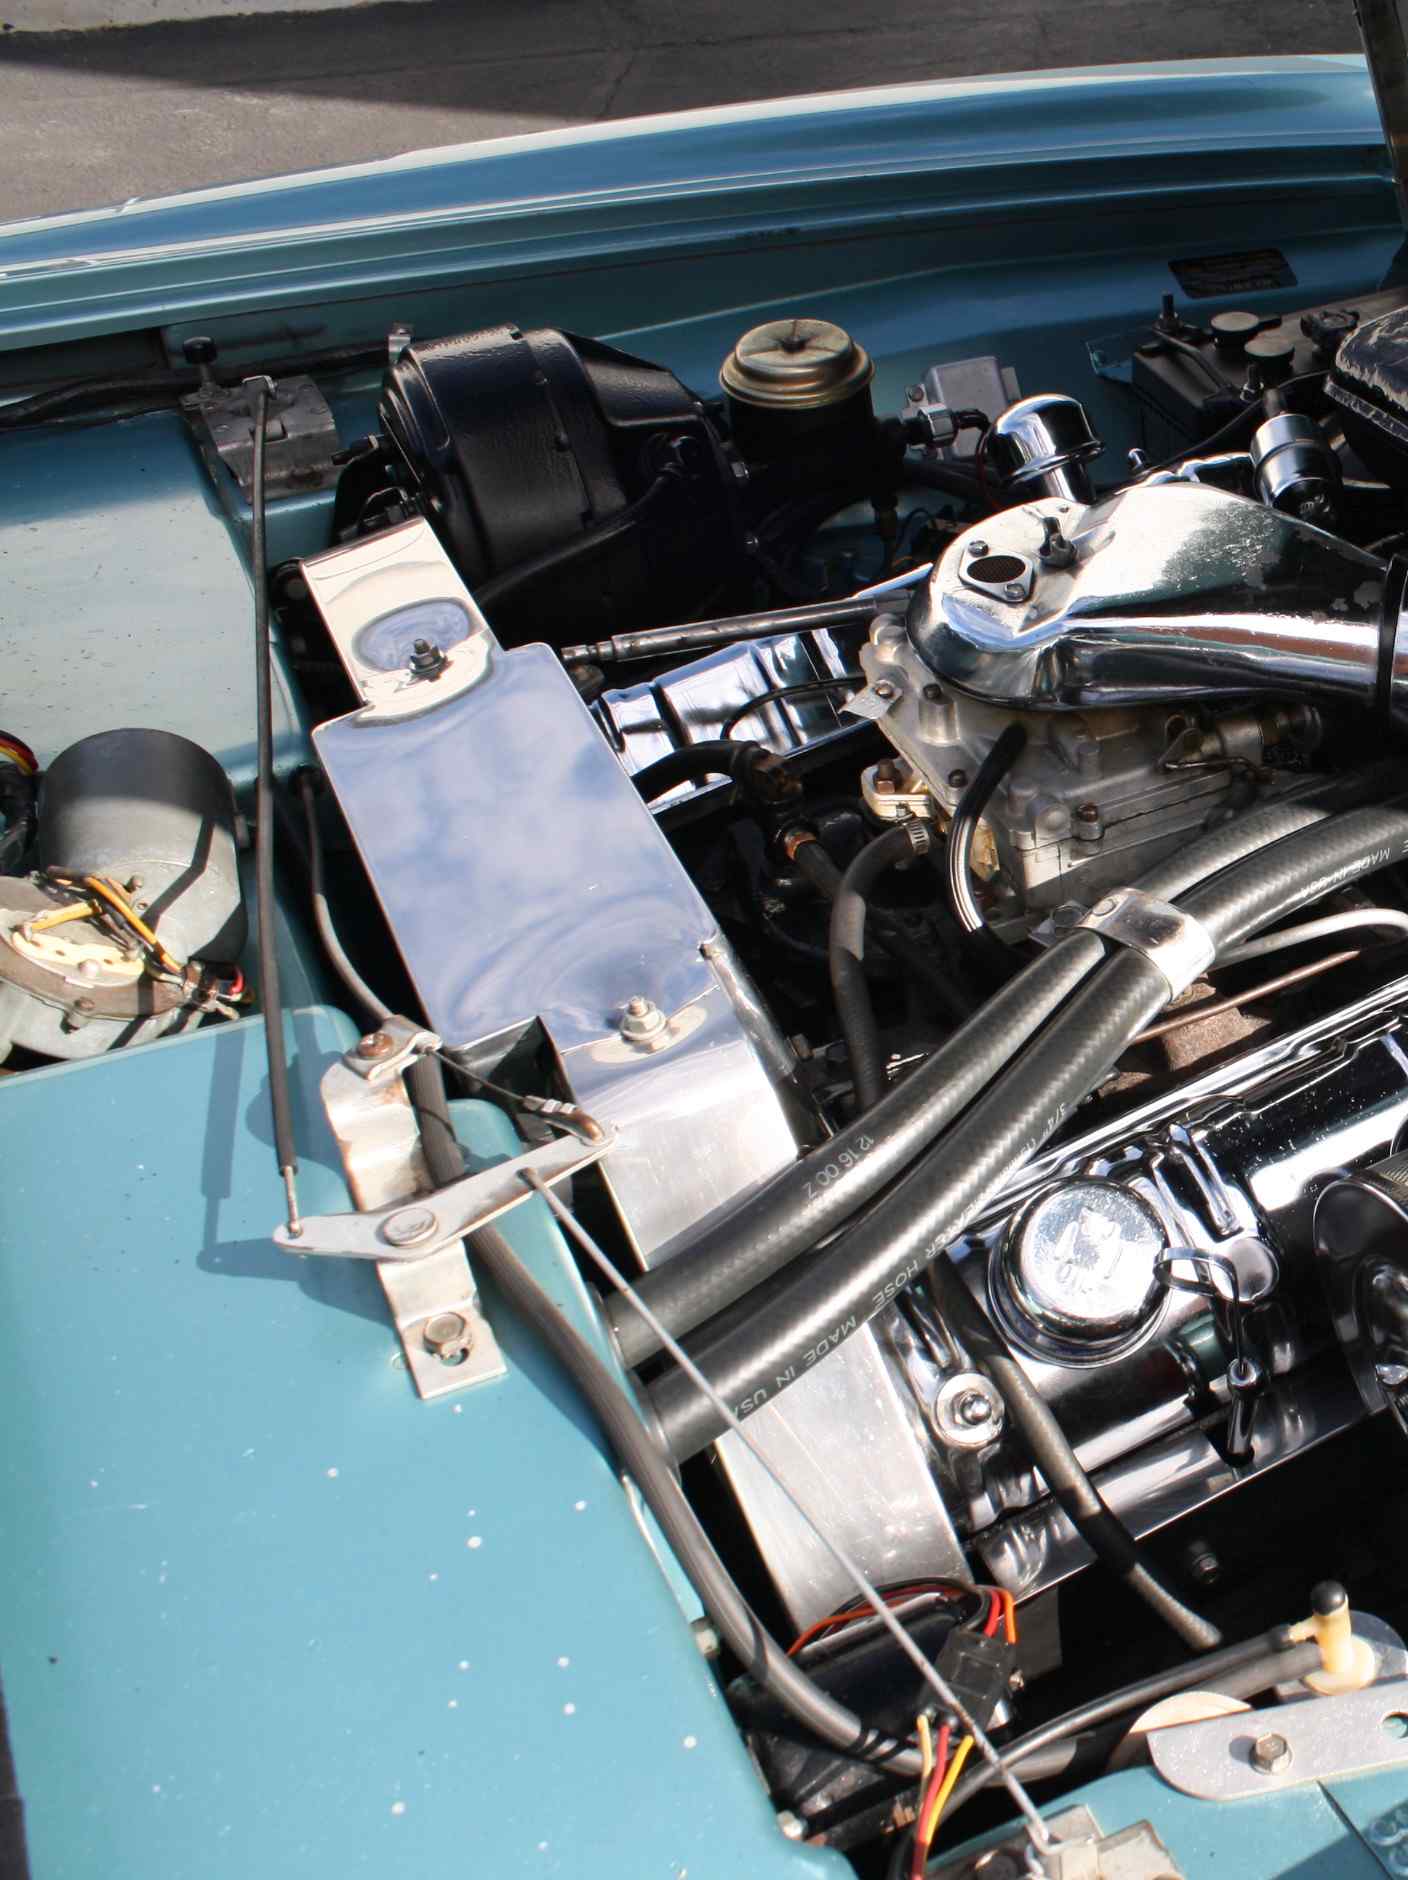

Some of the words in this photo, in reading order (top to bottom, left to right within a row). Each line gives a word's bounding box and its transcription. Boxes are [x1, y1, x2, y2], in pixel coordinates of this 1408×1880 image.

[856, 1135, 874, 1151] 12
[838, 1147, 858, 1168] 16
[872, 1259, 919, 1310] HOSE
[803, 1315, 857, 1367] MADE
[775, 1365, 796, 1389] IN
